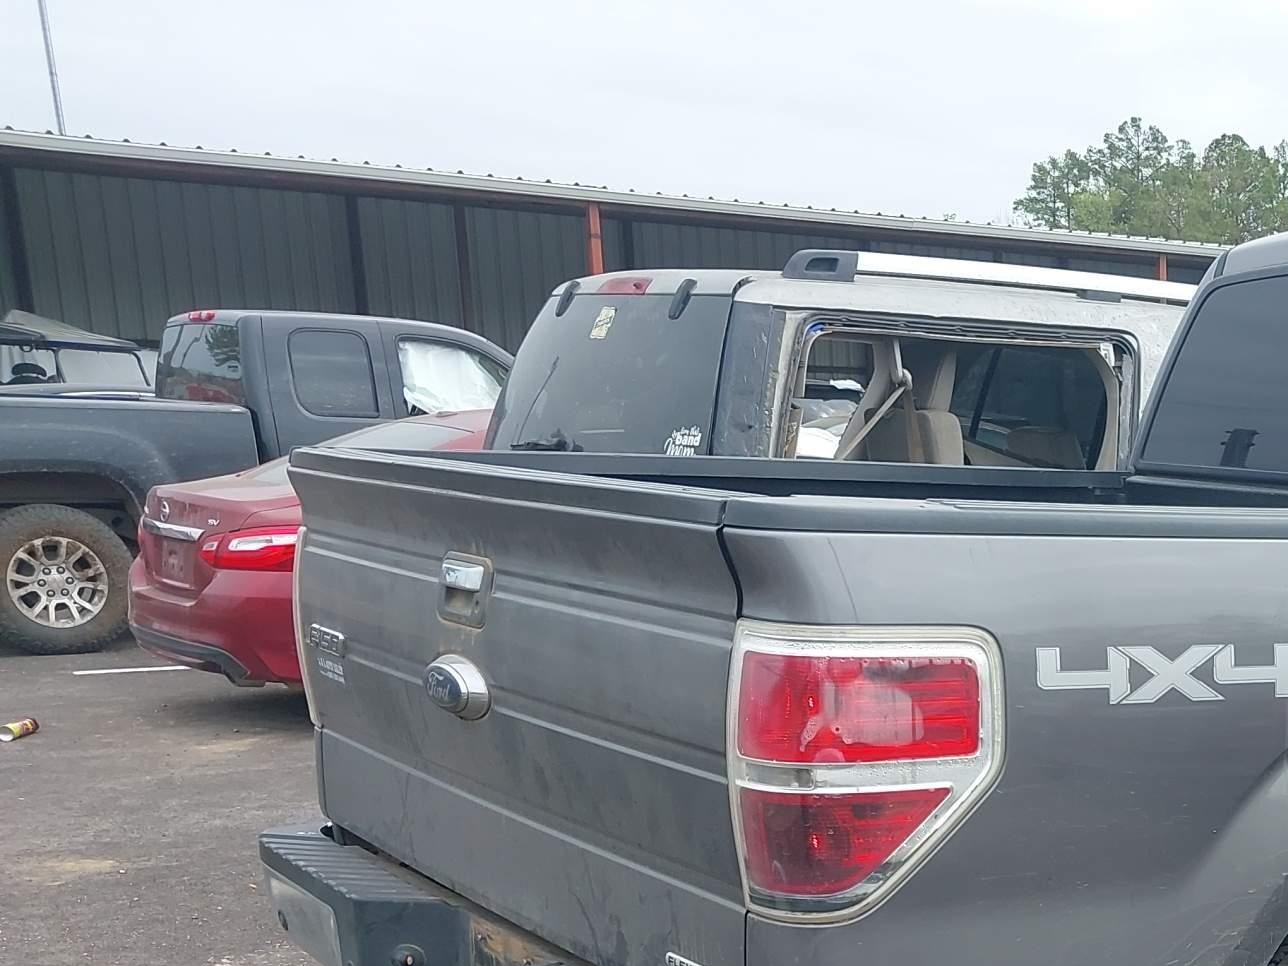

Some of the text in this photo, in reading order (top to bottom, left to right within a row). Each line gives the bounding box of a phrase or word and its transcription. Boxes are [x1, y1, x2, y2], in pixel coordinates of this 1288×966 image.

[675, 432, 702, 447] band
[207, 518, 221, 526] SV
[426, 671, 451, 701] Ford
